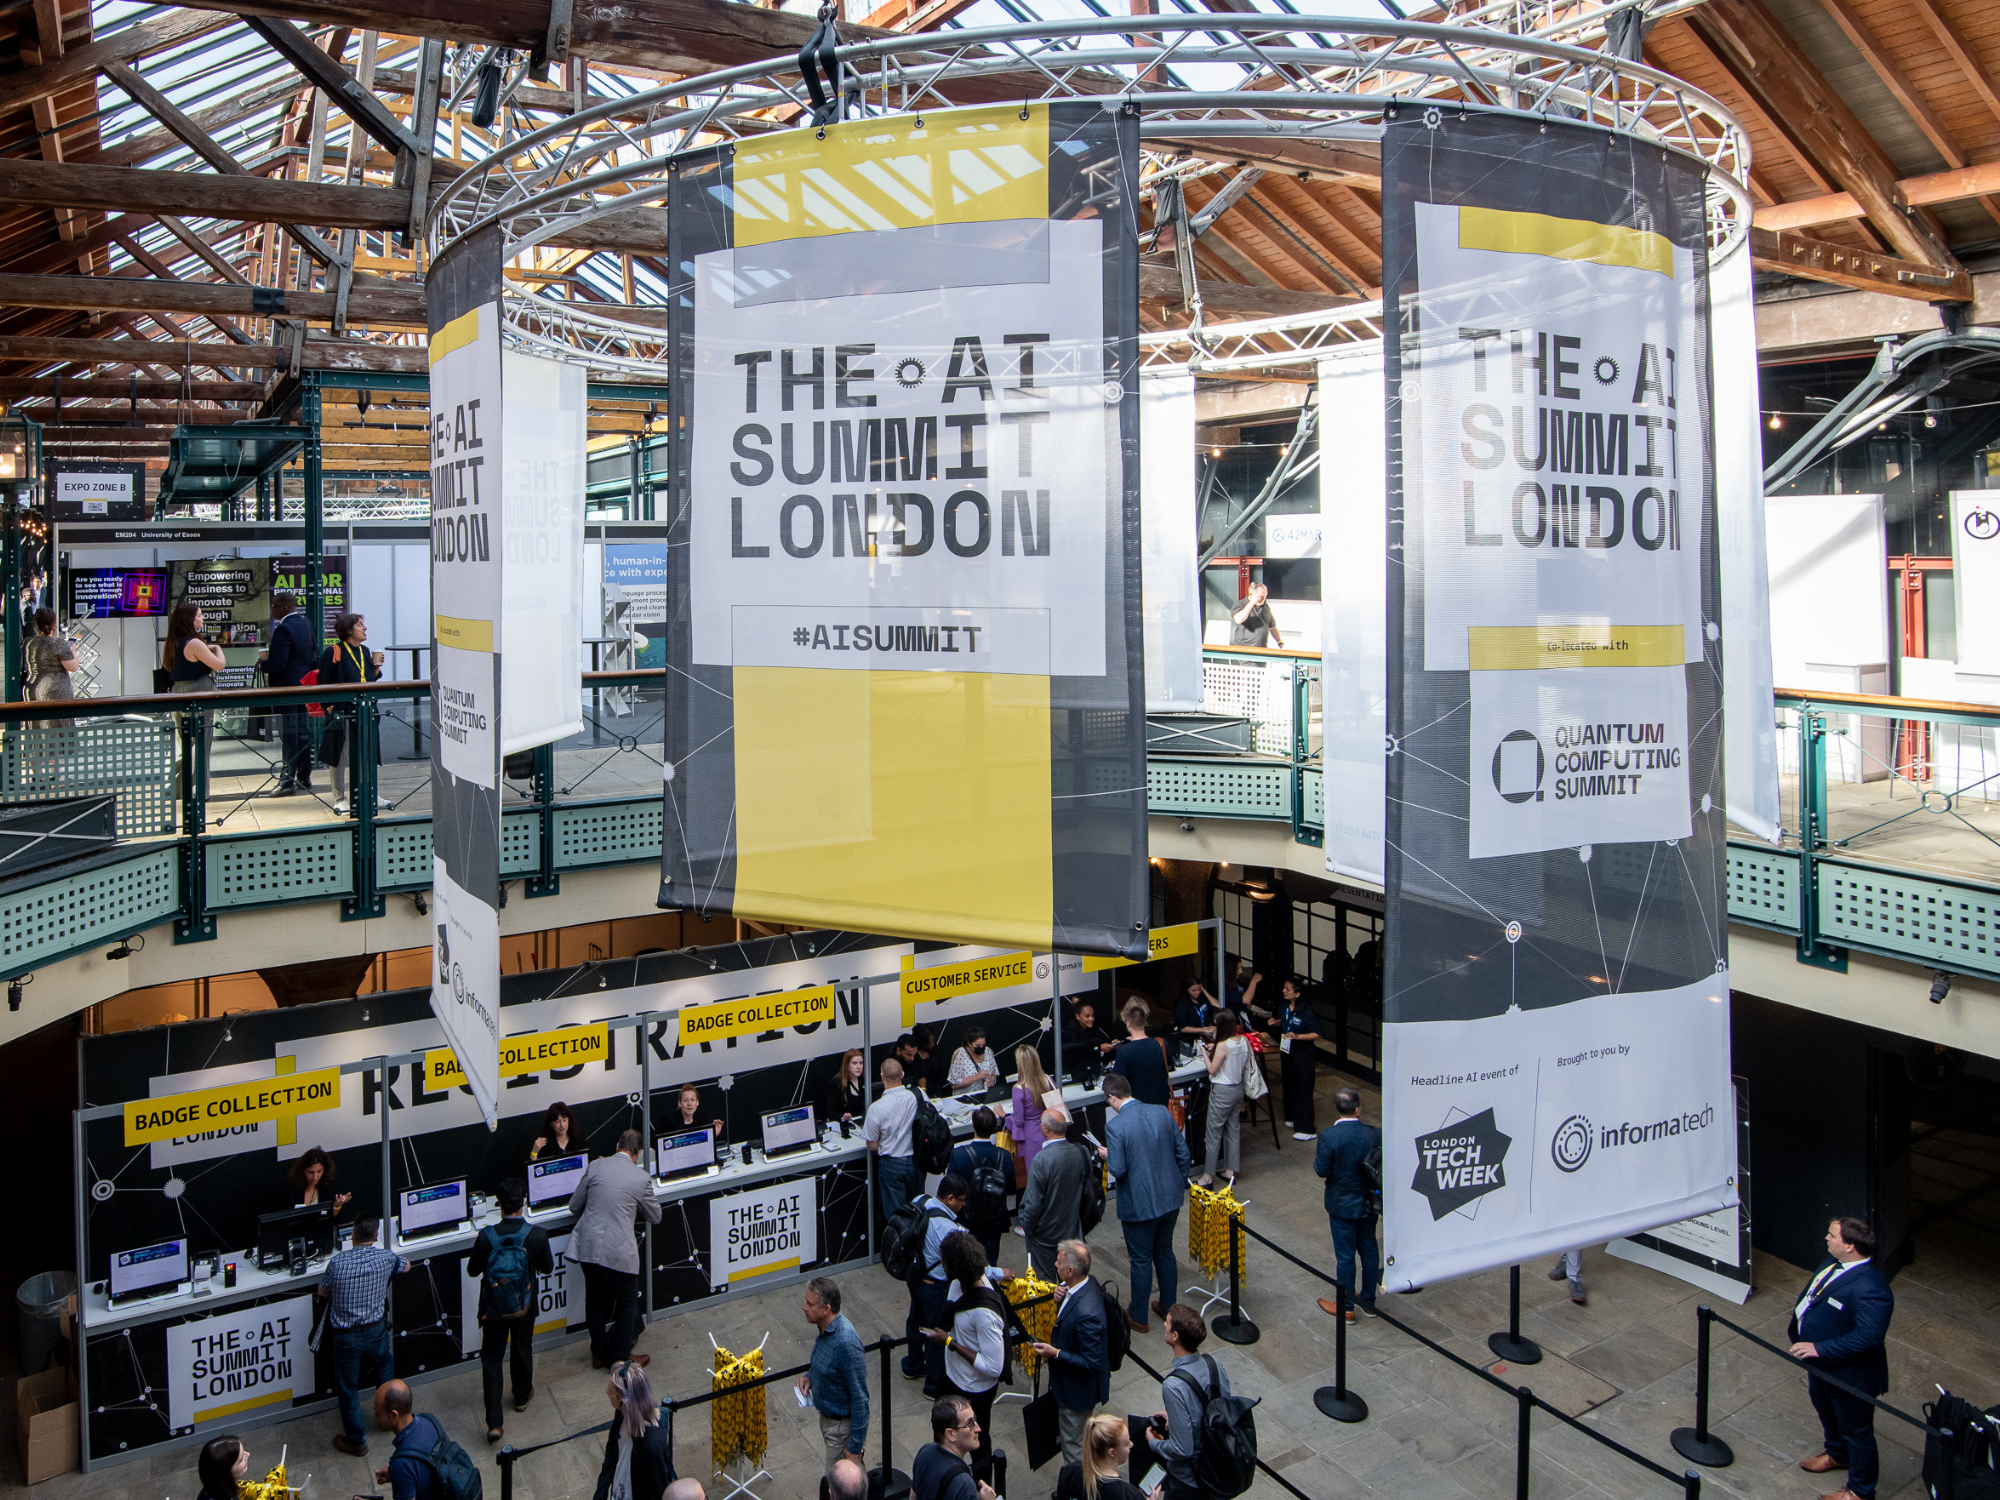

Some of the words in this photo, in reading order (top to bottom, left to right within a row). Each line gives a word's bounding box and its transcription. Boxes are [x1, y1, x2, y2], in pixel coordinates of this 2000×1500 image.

[734, 343, 877, 413] THE
[941, 333, 1050, 404] AI
[1458, 327, 1581, 400] THE
[1632, 343, 1676, 410] AI
[454, 398, 483, 453] AI
[729, 411, 1050, 486] SUMMIT
[1461, 402, 1677, 479] SUMMIT
[64, 483, 90, 491] EXPO
[93, 483, 117, 491] ZONE
[731, 490, 1051, 558] LONDON
[1463, 480, 1681, 551] LONDON
[188, 571, 250, 581] Empowering
[274, 575, 294, 588] AI
[619, 567, 641, 577] with
[188, 584, 233, 593] business
[235, 584, 246, 592] to
[188, 597, 232, 606] innovate
[793, 624, 982, 653] #AISUMMIT
[1547, 640, 1597, 651] Co-located
[1602, 640, 1629, 650] with
[443, 685, 475, 709] QUANTUM
[443, 703, 487, 731] COMPUTING
[444, 722, 468, 745] SUMMIT
[1555, 723, 1664, 748] QUANTUM
[1555, 747, 1681, 774] COMPUTING
[1555, 774, 1642, 800] SUMMIT
[906, 972, 971, 994] CUSTOMER
[974, 961, 1027, 982] SERVICE
[686, 1013, 733, 1033] BADGE
[737, 996, 828, 1024] COLLECTION
[1557, 1050, 1587, 1067] Brought
[1590, 1049, 1598, 1059] to
[1600, 1046, 1616, 1059] you
[1618, 1045, 1630, 1056] by
[1411, 1074, 1463, 1086] Headline
[1466, 1072, 1478, 1082] AI
[1480, 1068, 1507, 1081] event
[1508, 1064, 1519, 1076] of
[135, 1104, 200, 1131] BADGE
[206, 1081, 332, 1117] COLLECTION
[1424, 1136, 1475, 1149] LONDON
[1422, 1145, 1481, 1170] TECH
[1436, 1164, 1499, 1190] WEEK
[728, 1203, 763, 1226] THE
[777, 1195, 800, 1215] AI
[728, 1213, 800, 1244] SUMMIT
[1710, 1225, 1730, 1237] LEVEL
[728, 1231, 800, 1263] LONDON
[192, 1329, 240, 1357] THE
[259, 1316, 291, 1342] AI
[192, 1338, 291, 1379] SUMMIT
[193, 1359, 292, 1401] LONDON
